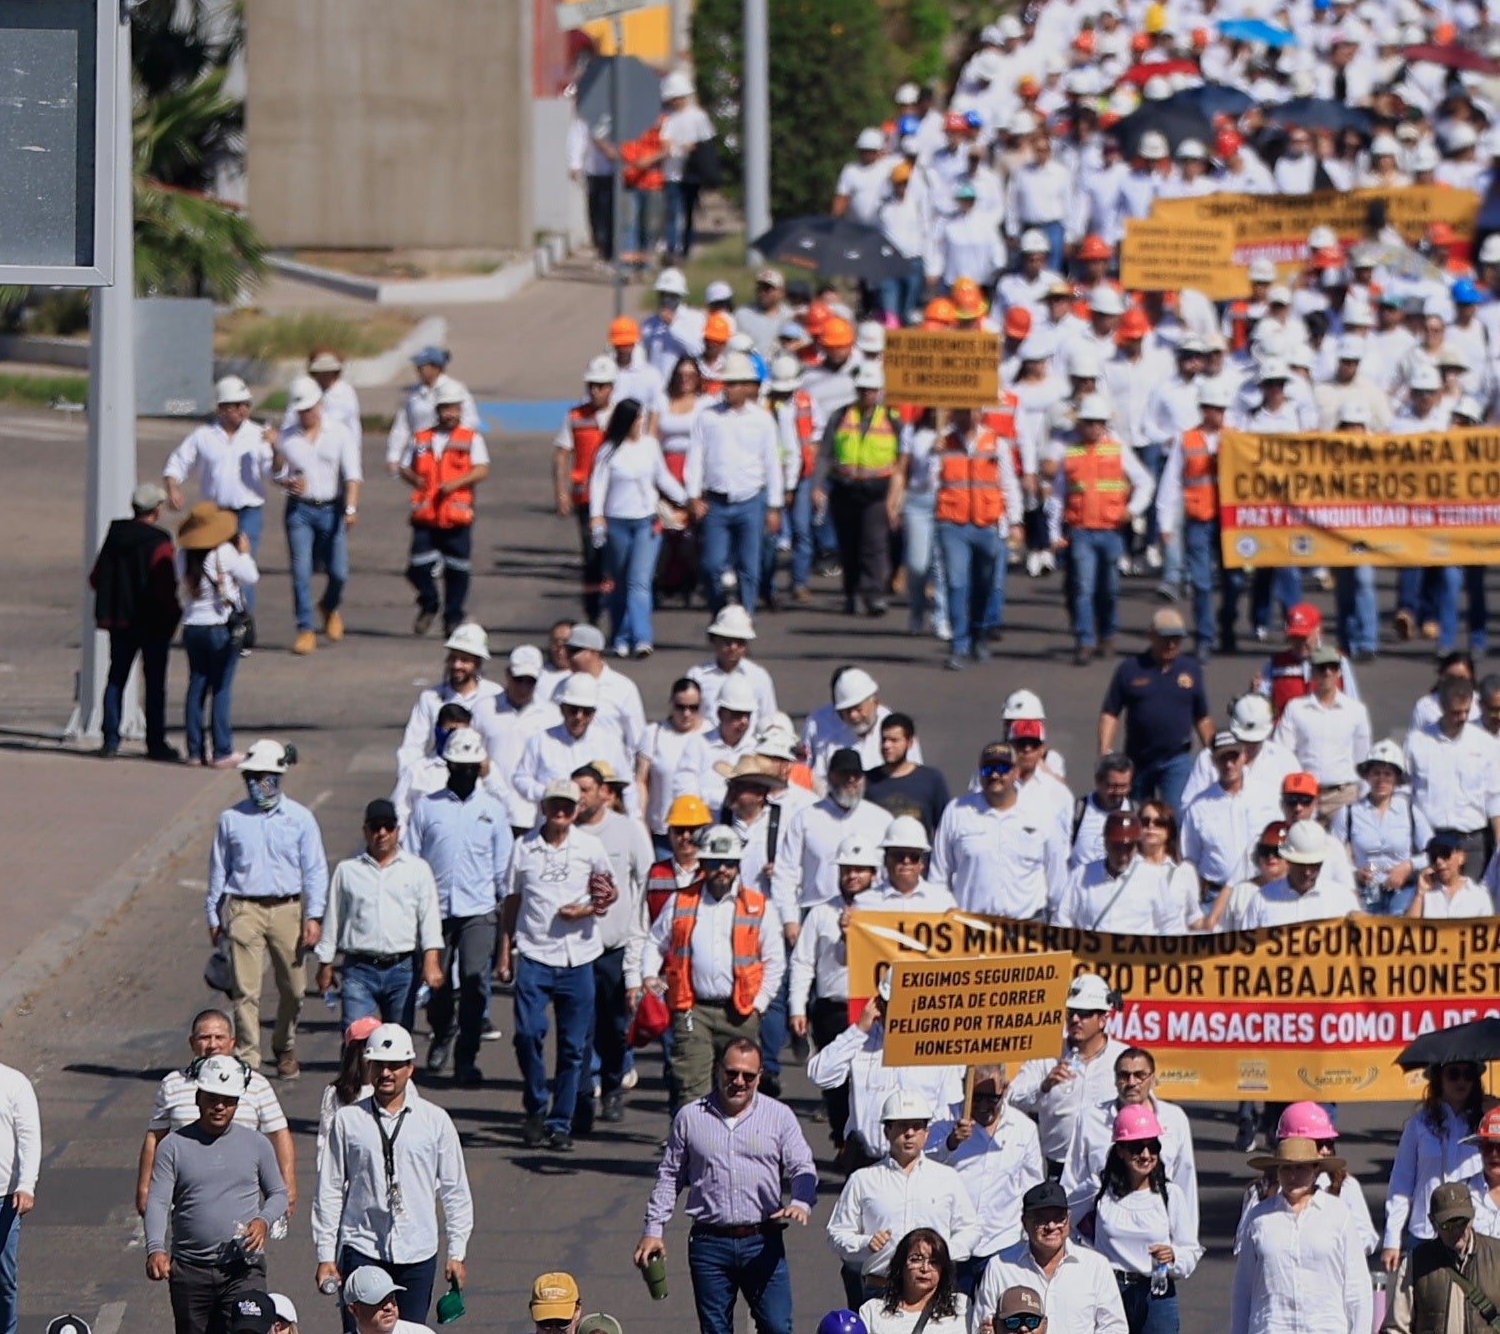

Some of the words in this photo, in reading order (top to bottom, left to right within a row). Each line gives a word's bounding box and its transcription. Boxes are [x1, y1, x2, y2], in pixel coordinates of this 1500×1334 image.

[1253, 435, 1373, 466] JUSTICIA
[1383, 437, 1454, 464] PARA
[1235, 466, 1416, 499] COMPAÑEROS
[1425, 471, 1457, 498] DE
[898, 921, 953, 953] LOS
[964, 922, 1100, 954] MINEROS
[1112, 932, 1258, 955] EXIGIMOS
[1267, 922, 1448, 957] SEGURIDAD.
[902, 971, 970, 987] EXIGIMOS
[975, 965, 1060, 985] SEGURIDAD.
[1145, 966, 1204, 996] POR
[1214, 963, 1377, 998] TRABAJAR
[912, 994, 963, 1013] ¡BASTA
[968, 993, 986, 1008] DE
[990, 989, 1045, 1006] CORRER
[889, 1015, 950, 1033] PELIGRO
[954, 1016, 982, 1031] POR
[988, 1010, 1062, 1029] TRABAJAR
[1104, 1002, 1161, 1040] MÁS
[1168, 1009, 1314, 1045] MASACRES
[1320, 1011, 1394, 1042] COMO
[1402, 1010, 1436, 1040] LA
[915, 1035, 1032, 1055] HONESTAMENTE!
